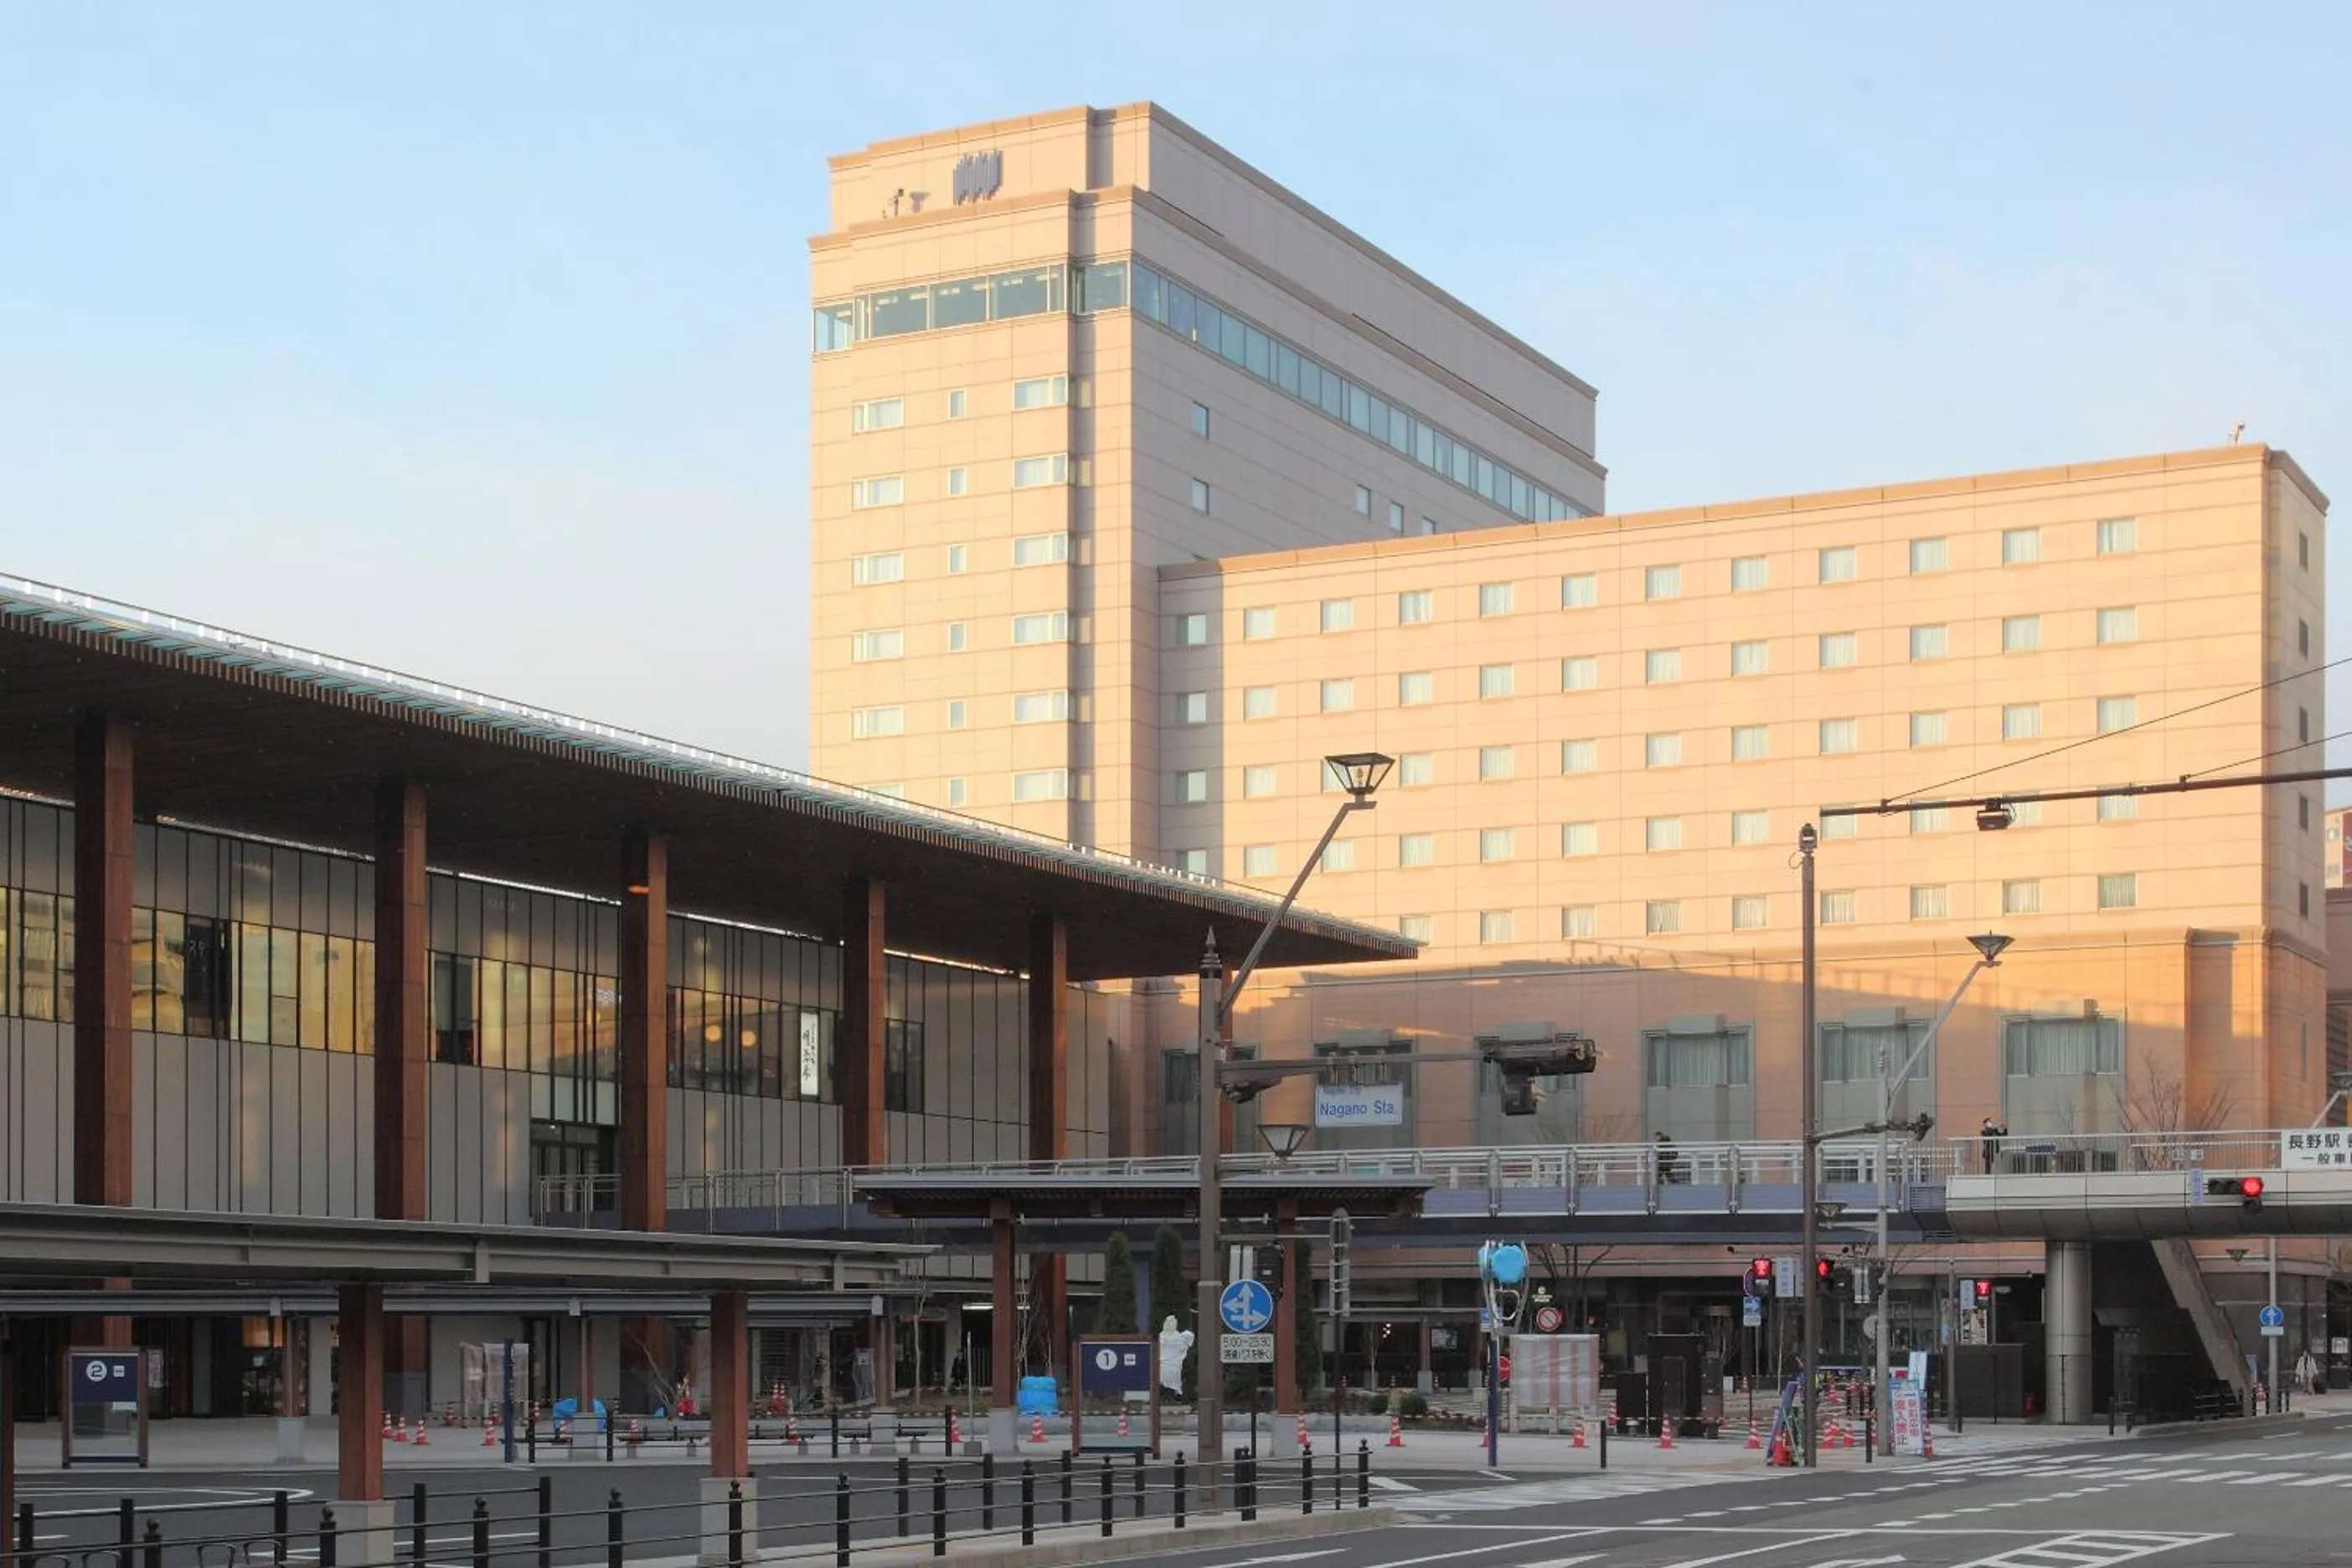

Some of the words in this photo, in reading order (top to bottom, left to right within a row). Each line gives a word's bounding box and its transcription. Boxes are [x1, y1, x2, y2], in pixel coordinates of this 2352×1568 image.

[1319, 1101, 1368, 1119] Nagano
[2288, 1133, 2340, 1149] 長野駅
[2301, 1153, 2352, 1165] 一般車
